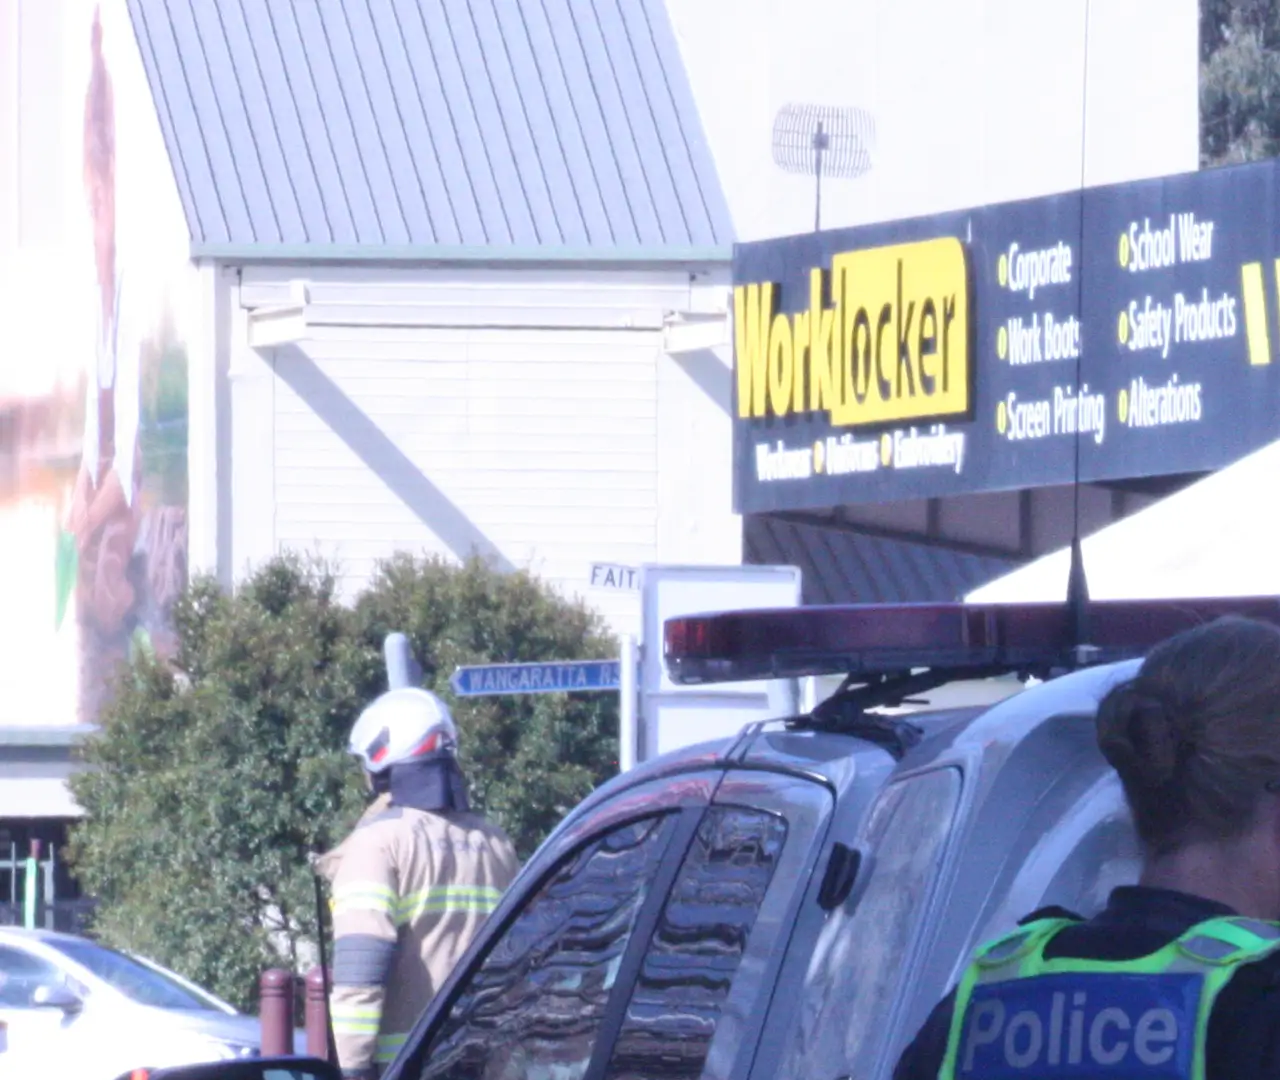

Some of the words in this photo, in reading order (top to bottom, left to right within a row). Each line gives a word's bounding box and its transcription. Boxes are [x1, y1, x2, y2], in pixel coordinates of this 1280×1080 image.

[1008, 241, 1072, 300] Corporate
[1129, 214, 1176, 272] School
[1179, 212, 1214, 262] Wear
[734, 258, 956, 418] Worklocker
[1008, 313, 1042, 365] Work
[1044, 312, 1081, 360] Boots
[1128, 295, 1172, 359] Safety
[1174, 288, 1237, 343] Products
[1007, 392, 1051, 440] Screen
[1054, 384, 1105, 444] Printing
[1128, 373, 1202, 428] Alterations
[590, 565, 641, 591] FAIT
[468, 666, 588, 690] WANGARATTA
[961, 991, 1179, 1071] Police
